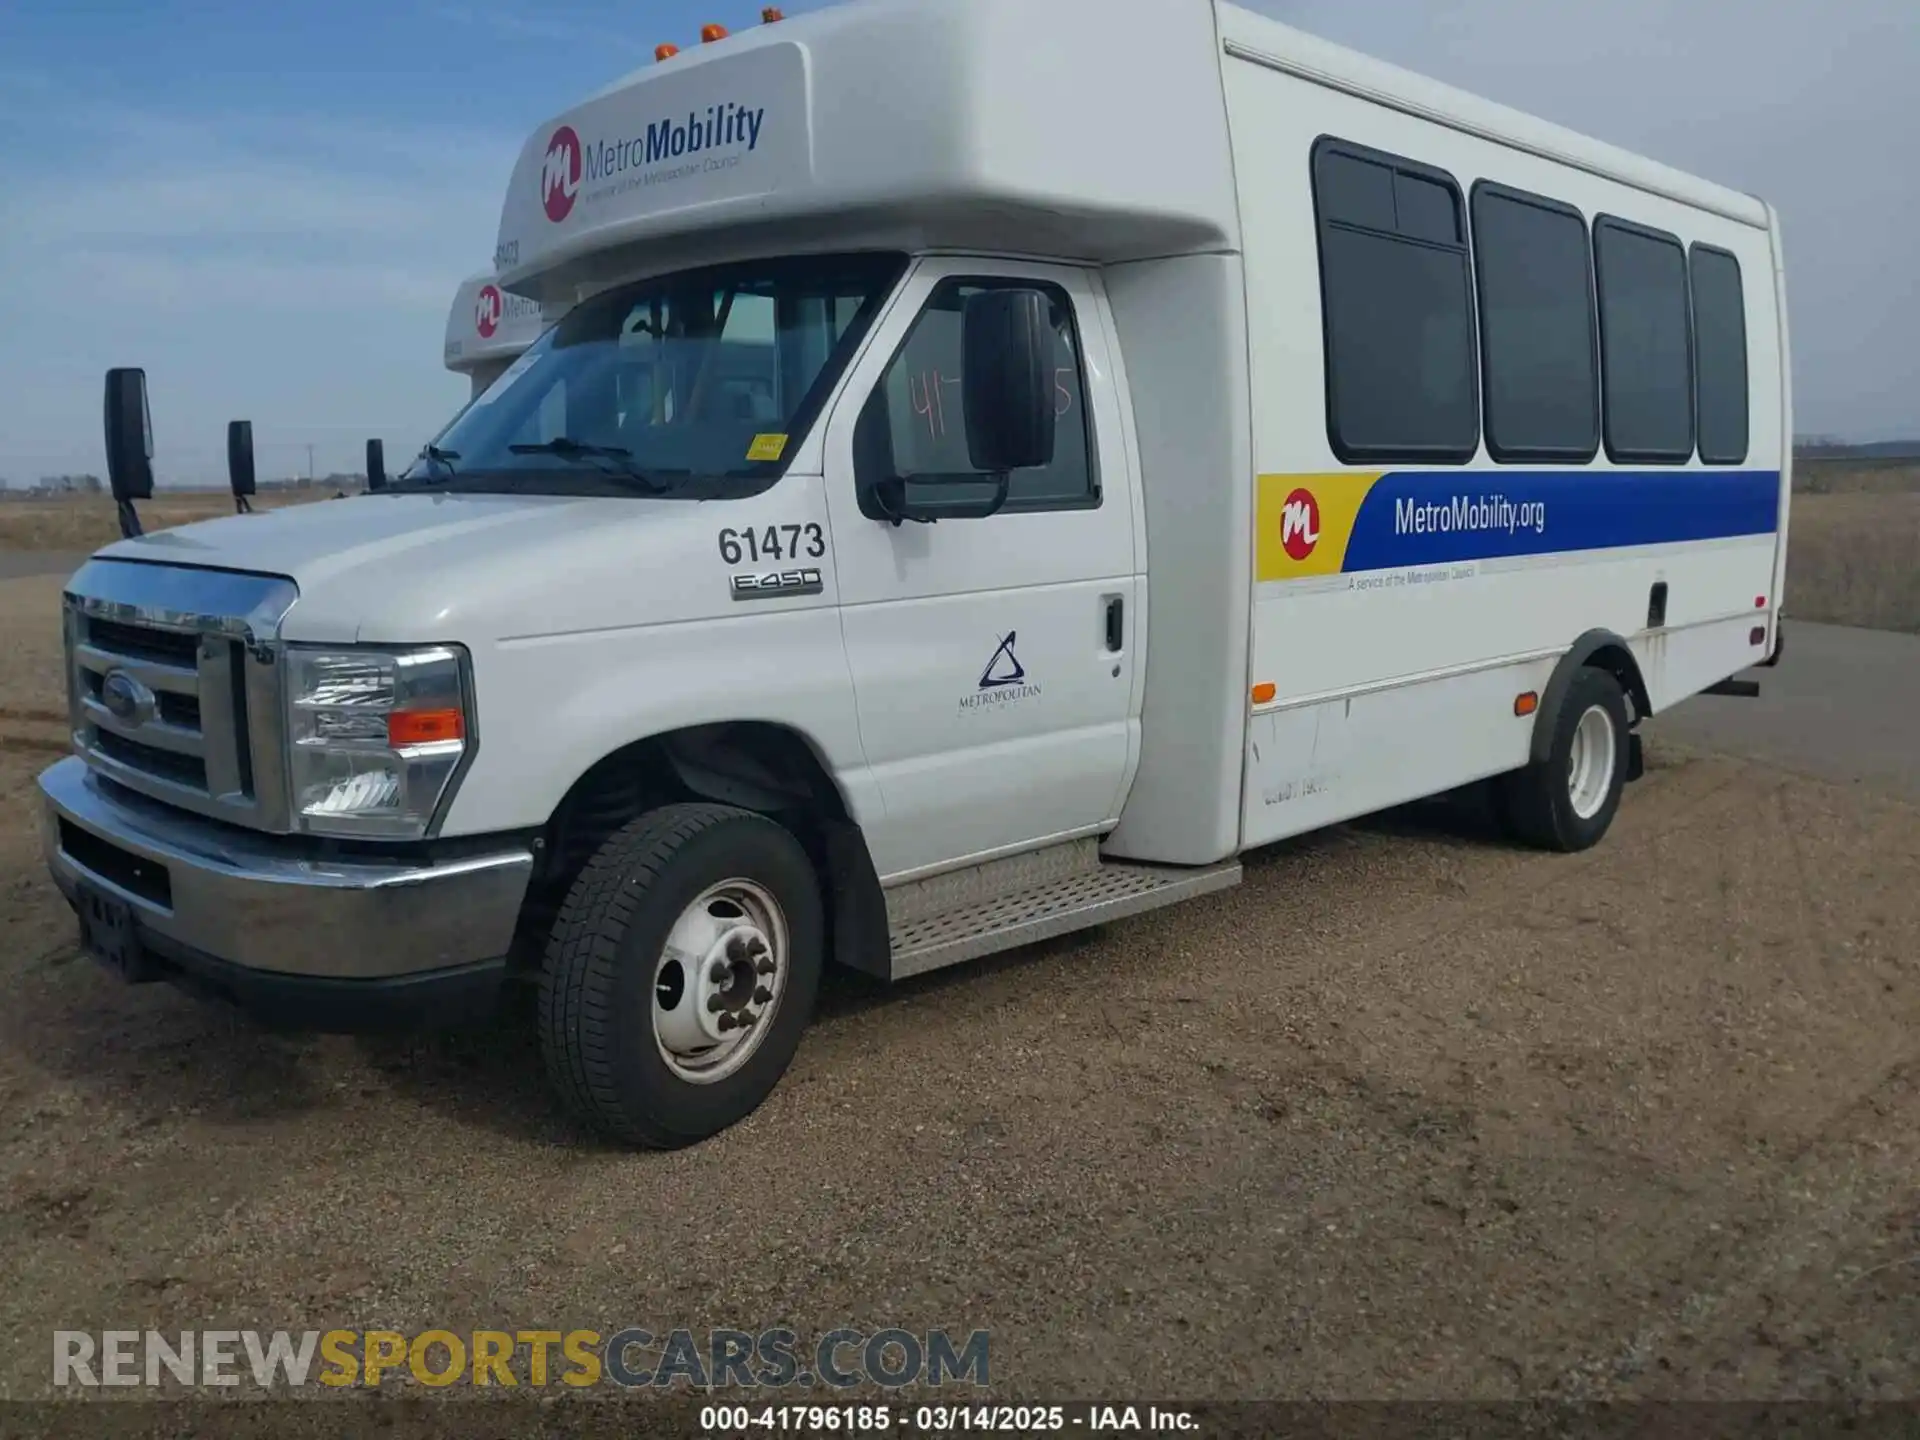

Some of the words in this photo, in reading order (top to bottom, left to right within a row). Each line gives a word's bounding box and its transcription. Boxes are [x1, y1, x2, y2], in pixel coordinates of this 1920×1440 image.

[584, 101, 765, 182] MetroMobility
[1395, 493, 1546, 536] MetroMobility.org
[718, 522, 826, 565] 61473
[958, 683, 1042, 709] METROPOLITAN
